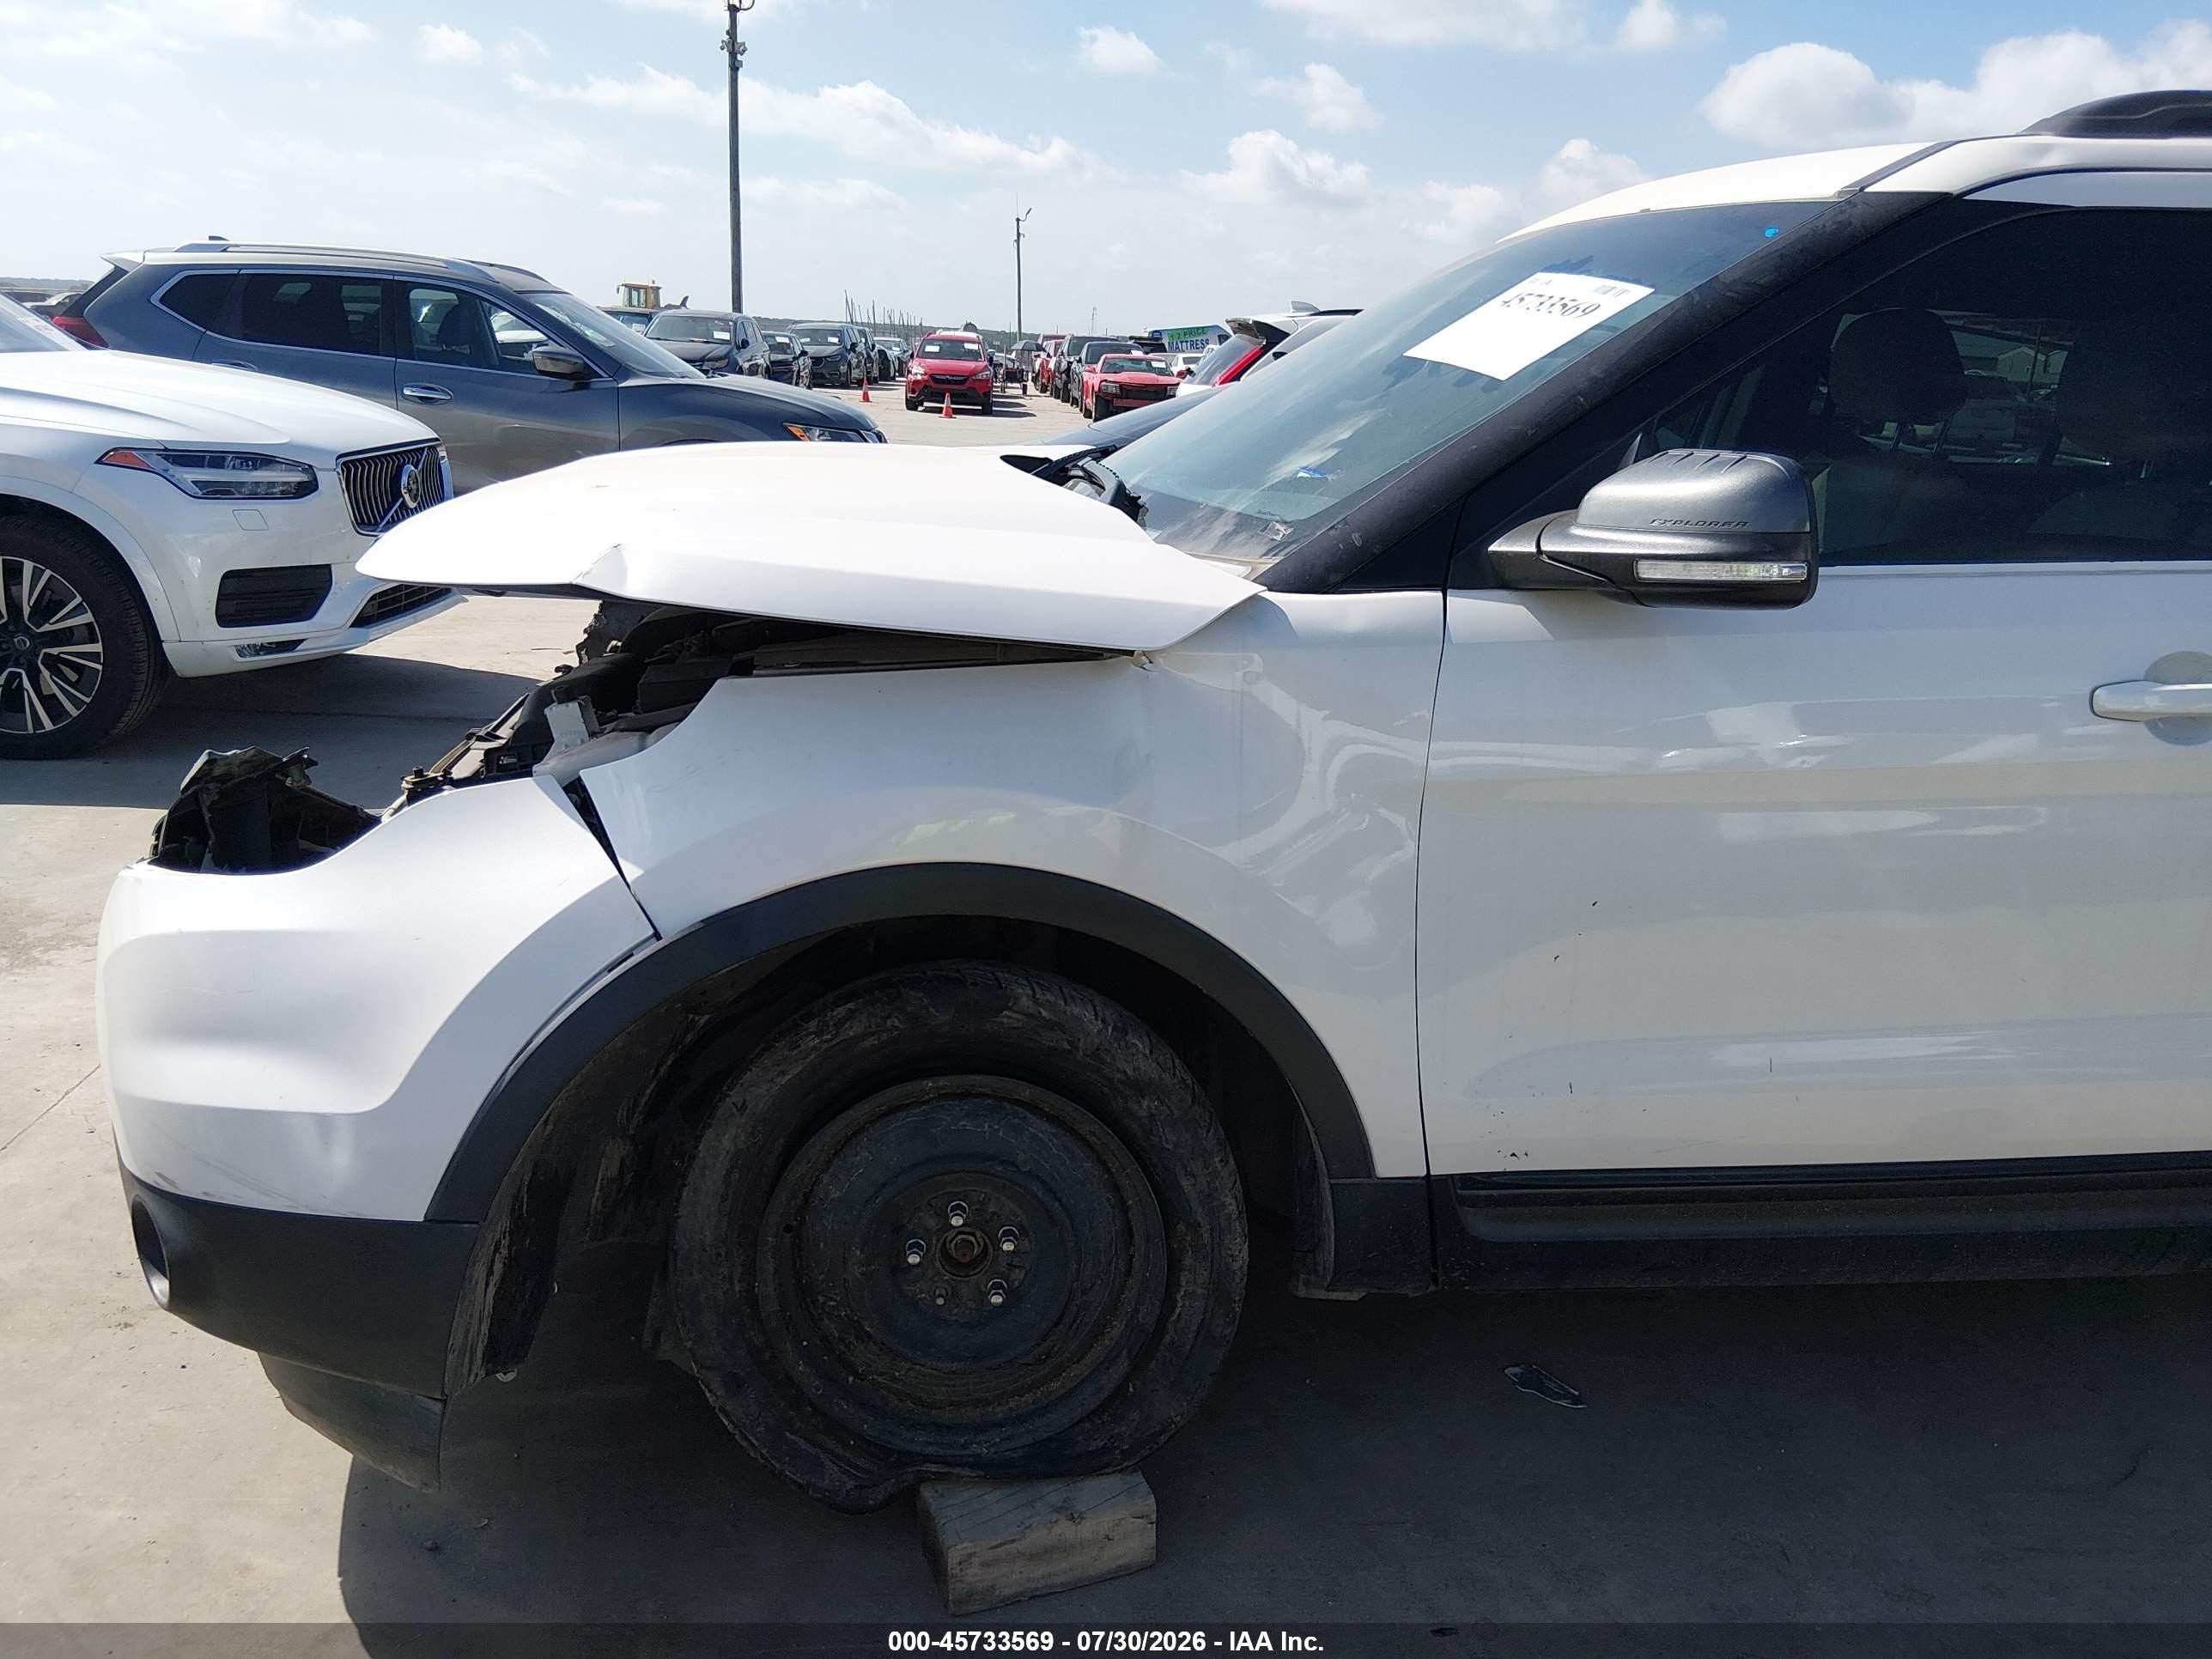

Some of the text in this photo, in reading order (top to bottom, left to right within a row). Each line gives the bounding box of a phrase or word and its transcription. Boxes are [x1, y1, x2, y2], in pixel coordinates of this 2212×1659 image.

[1183, 328, 1207, 338] PRICE
[1168, 338, 1210, 353] MATTRESS
[1650, 519, 1750, 528] EXPLORER
